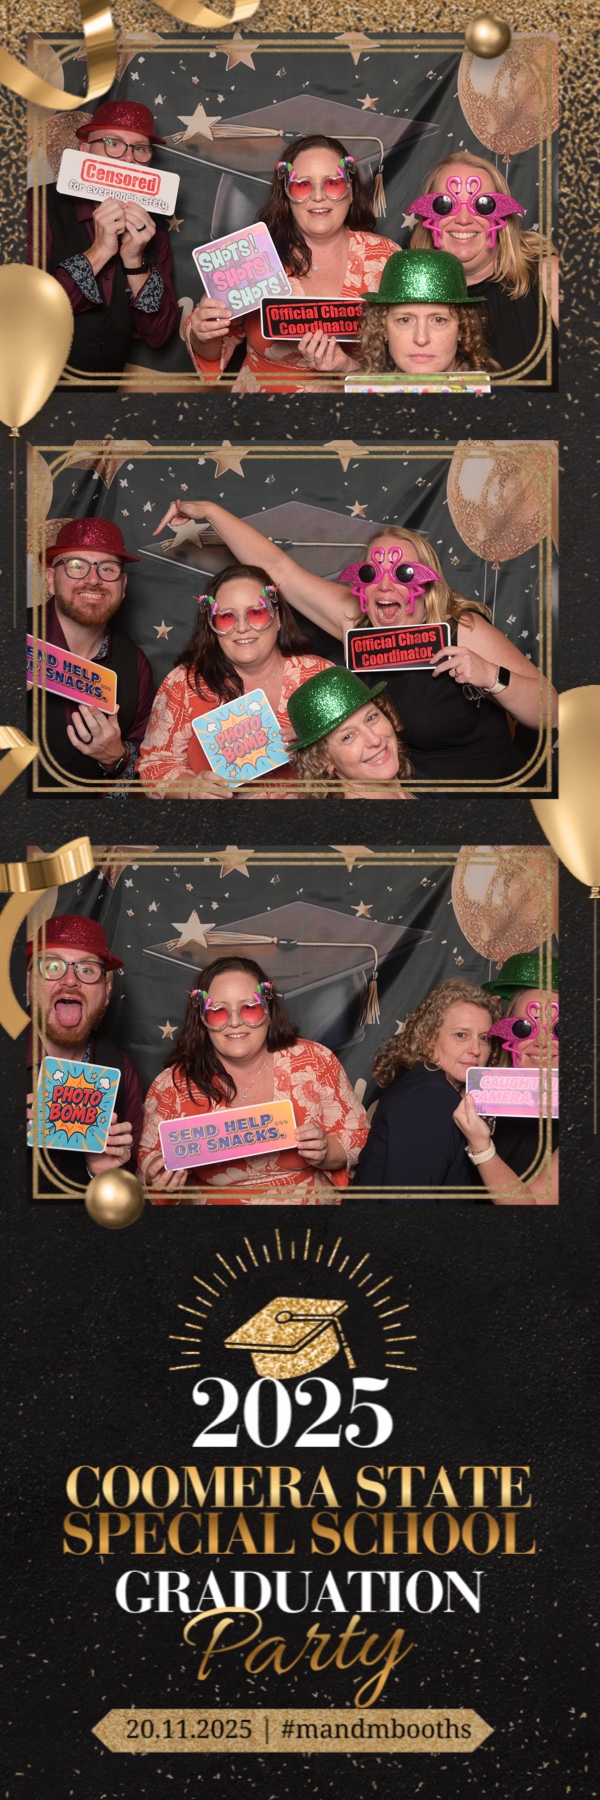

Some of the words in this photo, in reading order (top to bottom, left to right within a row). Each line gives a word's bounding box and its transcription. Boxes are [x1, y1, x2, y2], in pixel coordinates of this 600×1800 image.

[68, 179, 85, 192] for
[87, 184, 138, 202] everyone's
[86, 163, 157, 192] Censored
[198, 233, 259, 273] SHOTS!
[212, 251, 274, 292] SHOTS!
[227, 270, 289, 310] SHOTS!
[270, 306, 319, 321] Official
[320, 305, 363, 319] Chaos
[354, 634, 397, 653] Official
[398, 629, 437, 647] Chaos
[46, 667, 108, 702] SNACKS.
[214, 715, 263, 747] PHOTO
[221, 729, 268, 765] BOMB
[52, 1085, 103, 1105] PHOTO
[480, 1075, 540, 1090] CAUGHT
[49, 1103, 98, 1124] BOMB
[168, 1123, 220, 1144] SEND
[174, 1142, 201, 1158] OR
[206, 1127, 286, 1152] SNACKS.
